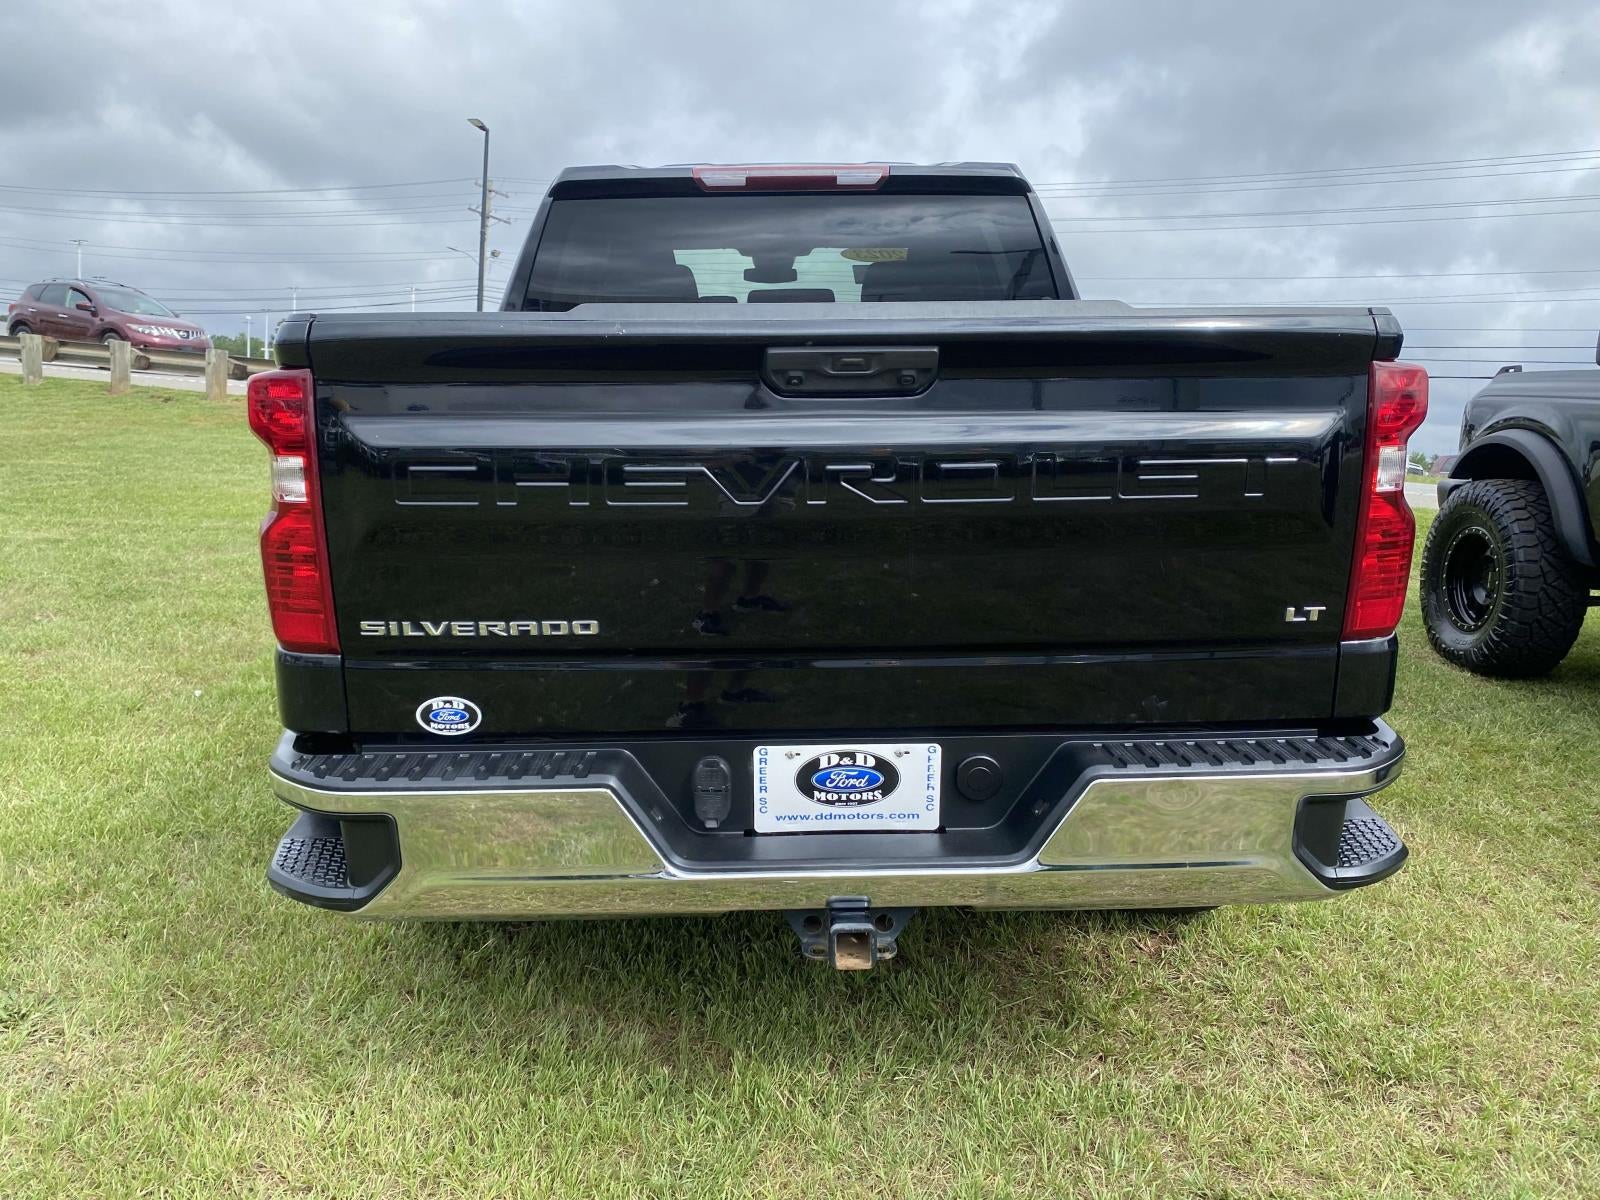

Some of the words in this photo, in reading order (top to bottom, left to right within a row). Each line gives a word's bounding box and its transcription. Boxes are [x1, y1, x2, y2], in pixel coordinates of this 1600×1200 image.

[394, 454, 1298, 505] CHEVROLET
[1285, 606, 1327, 622] LT
[359, 620, 599, 636] SILVERADO
[437, 711, 461, 721] Ford
[430, 722, 470, 730] MOTORS
[818, 752, 876, 770] D&D
[758, 747, 768, 794] GREER
[826, 770, 870, 788] Ford
[813, 789, 883, 802] MOTORS
[926, 795, 935, 812] SC
[759, 797, 768, 814] SC
[775, 811, 920, 822] www.ddmotors.com
